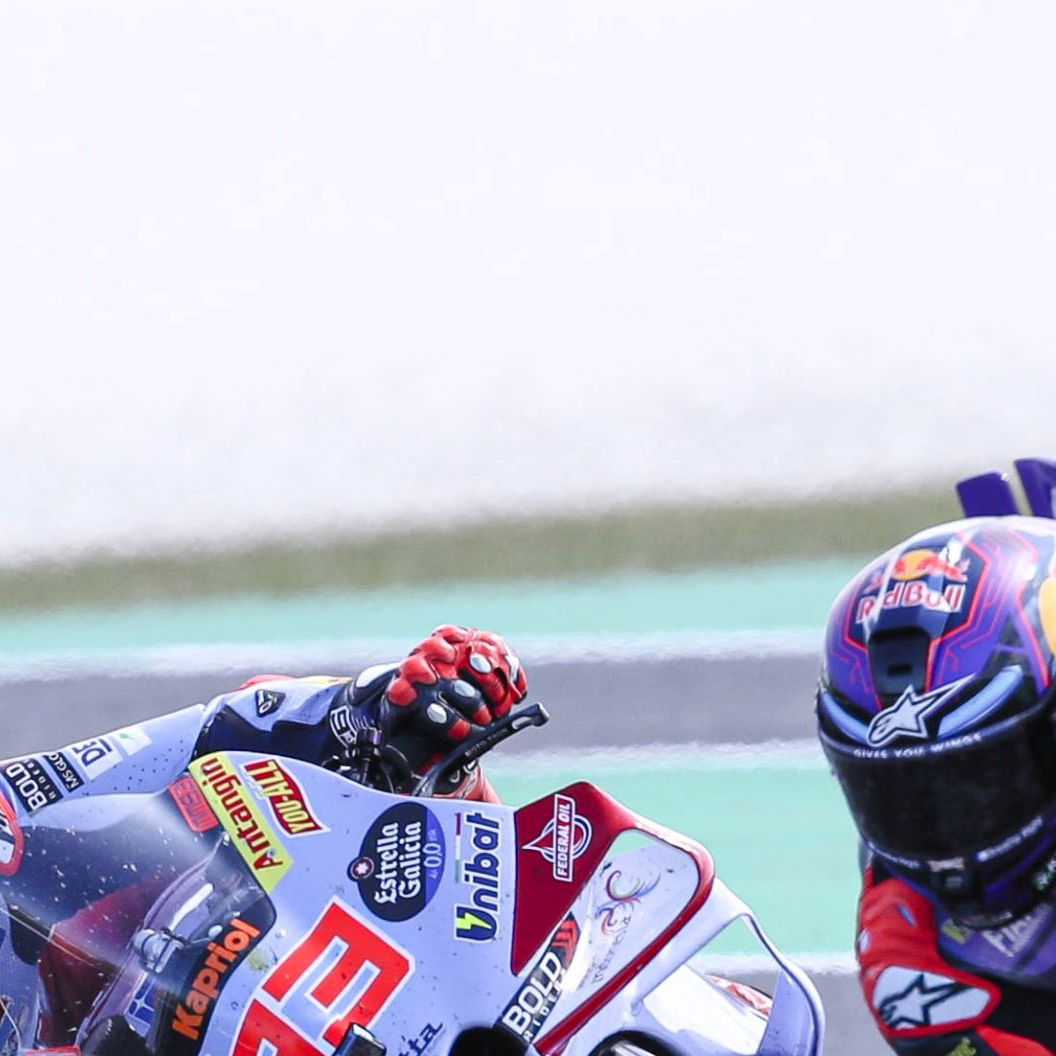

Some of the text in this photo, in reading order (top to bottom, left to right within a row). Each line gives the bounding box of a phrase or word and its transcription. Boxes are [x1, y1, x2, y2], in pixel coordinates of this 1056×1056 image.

[856, 583, 903, 624] Rd
[6, 763, 47, 811] BOLD
[200, 757, 284, 870] Antangin
[374, 822, 399, 904] Estrella
[398, 821, 422, 898] Galicia
[456, 812, 500, 941] Unibat
[557, 802, 571, 877] FEDERAL OIL
[172, 918, 260, 1040] Kapriol
[502, 952, 563, 1034] BOLD
